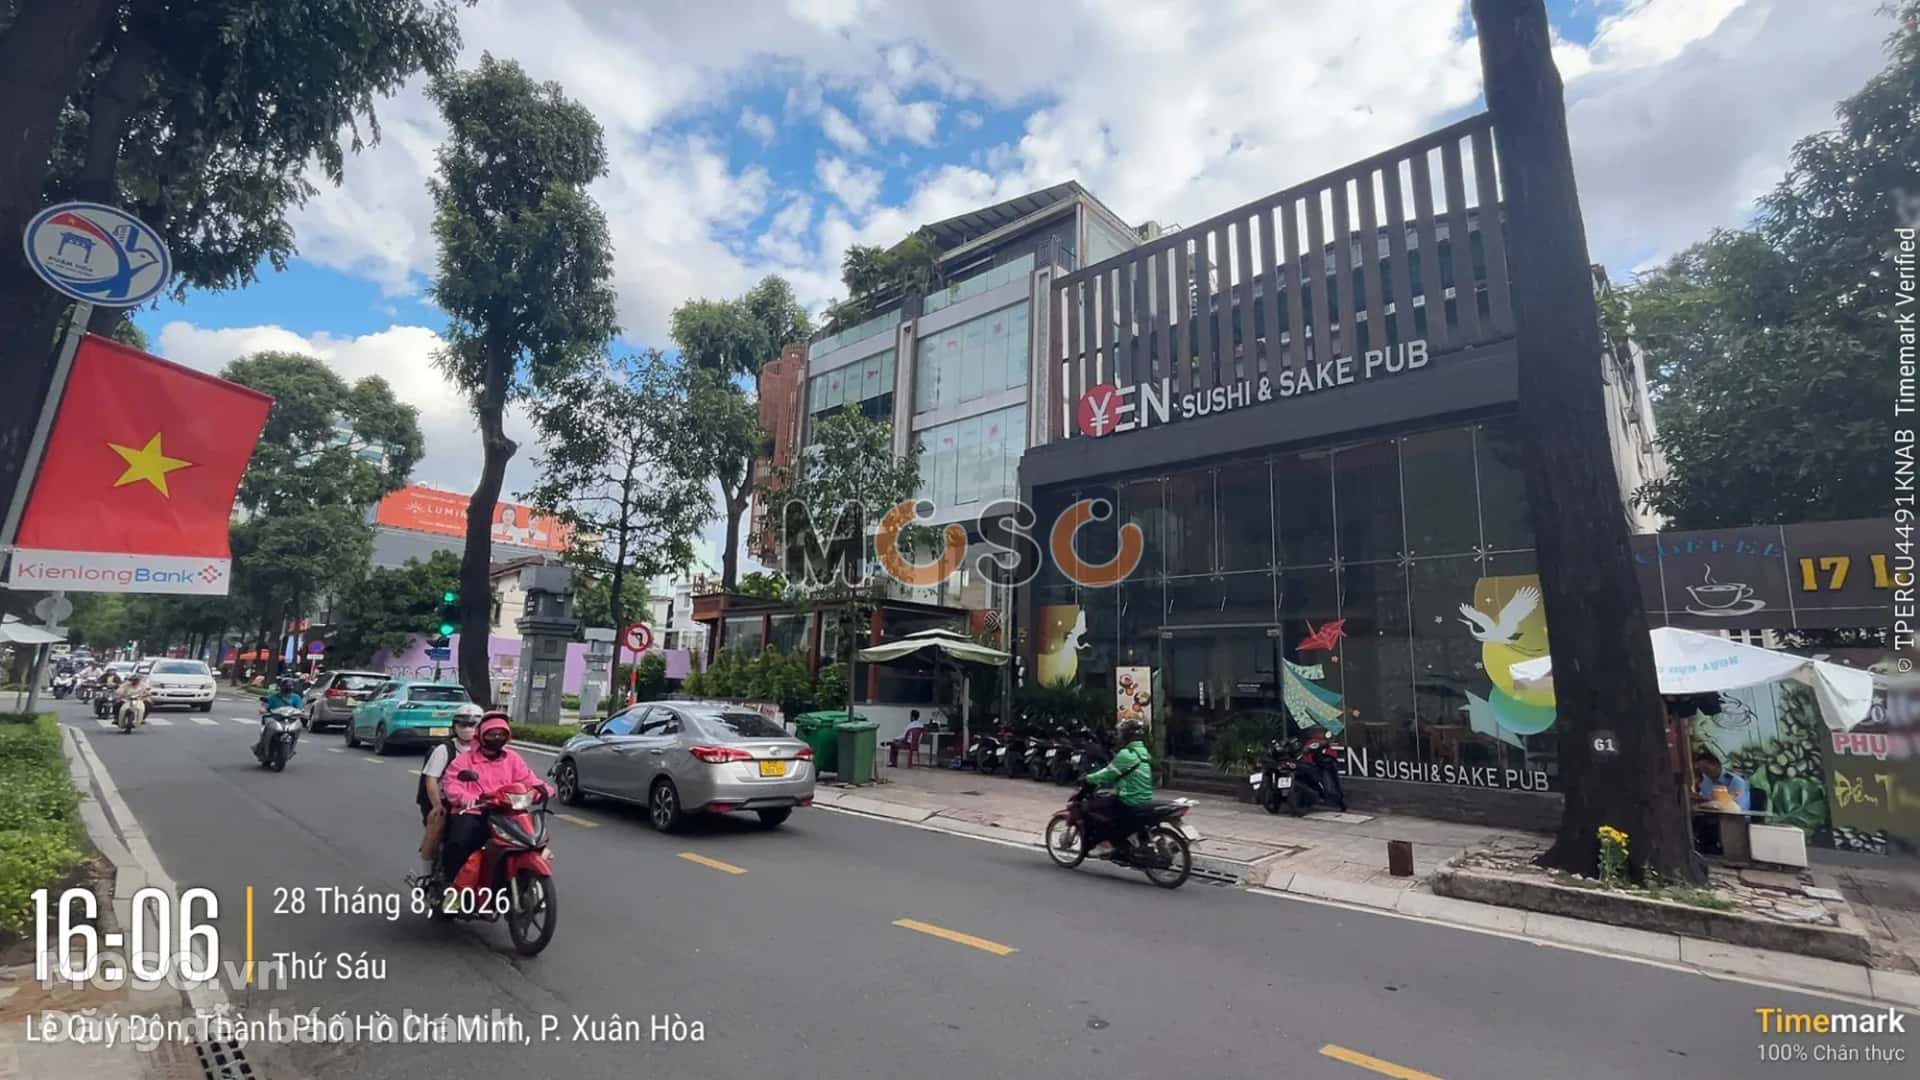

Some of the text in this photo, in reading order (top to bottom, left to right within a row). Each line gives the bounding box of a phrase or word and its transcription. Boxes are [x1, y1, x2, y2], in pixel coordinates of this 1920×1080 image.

[1182, 380, 1250, 419] SUSHI
[1257, 376, 1273, 402] &
[1279, 356, 1354, 397] SAKE
[1365, 339, 1429, 379] PUB
[18, 563, 193, 584] KienlongBank
[1799, 556, 1850, 591] 17
[1594, 738, 1616, 752] 61
[1330, 745, 1368, 777] EN
[1505, 768, 1550, 791] PUB
